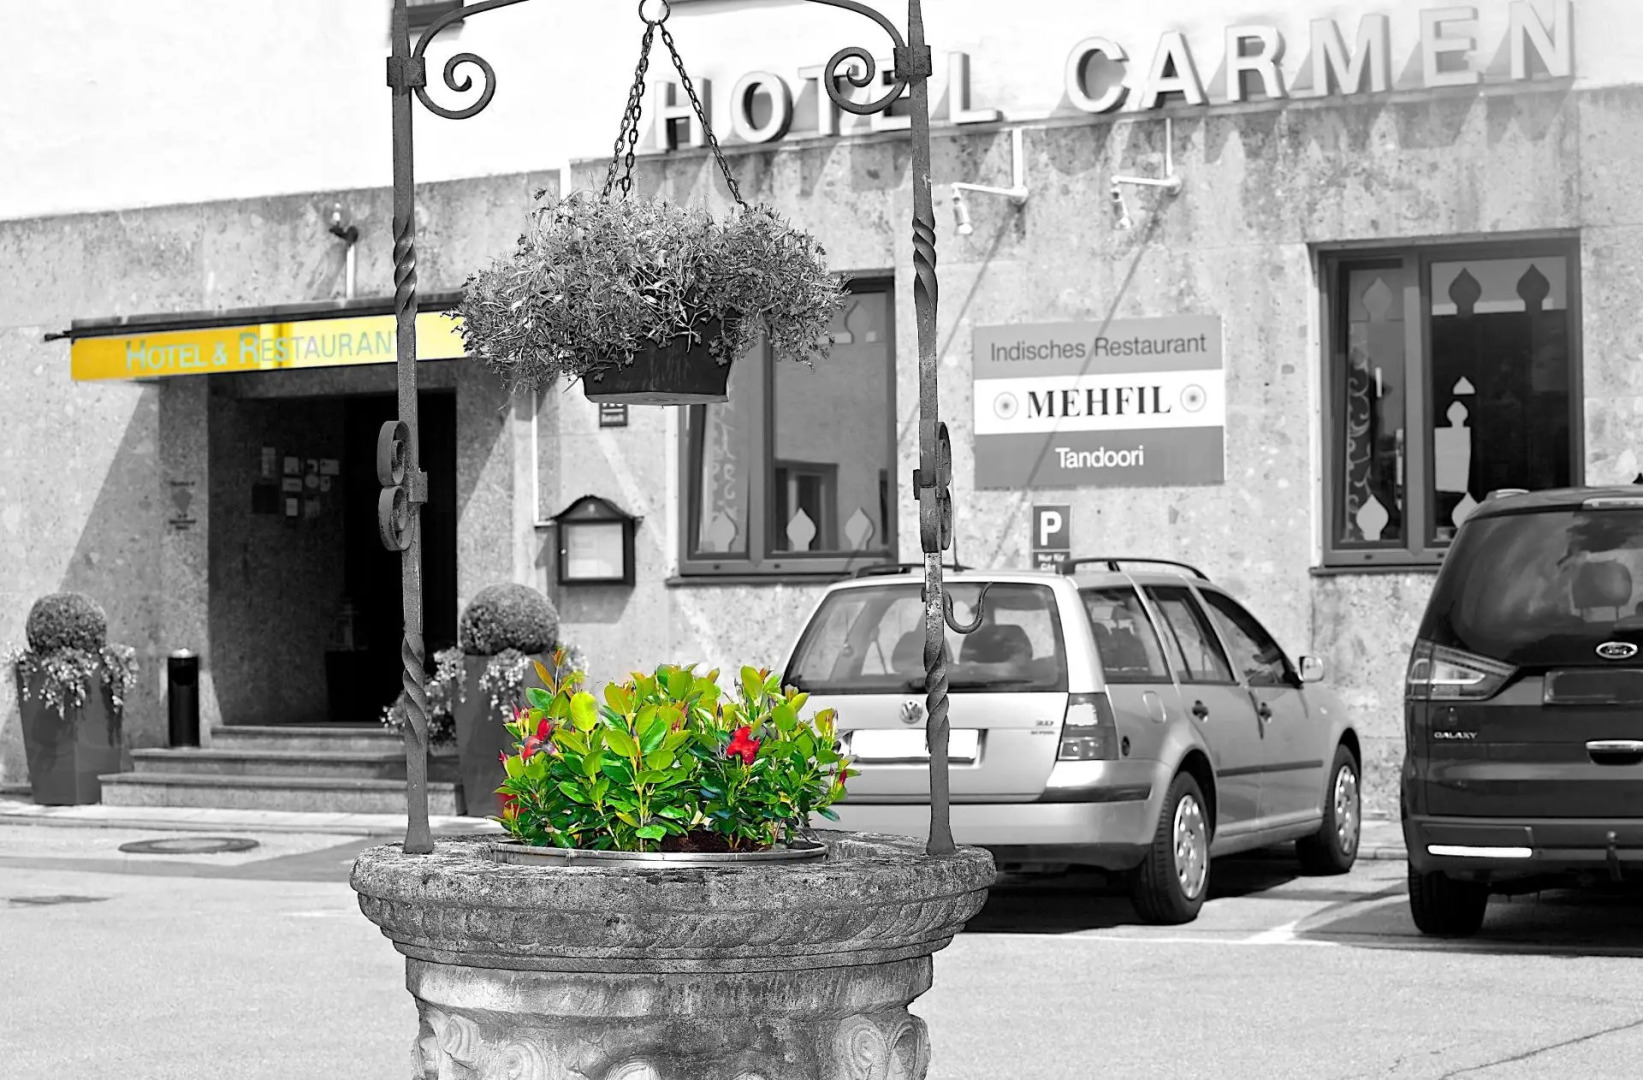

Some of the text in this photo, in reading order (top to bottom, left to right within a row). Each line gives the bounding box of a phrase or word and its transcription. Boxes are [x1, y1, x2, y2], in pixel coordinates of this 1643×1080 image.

[653, 0, 1577, 151] HOTEL CARMEN
[125, 330, 398, 370] HOTEL & RESTAURAN
[991, 334, 1207, 361] Indisches Restaurant
[1027, 385, 1172, 418] MEHFIL
[1055, 445, 1144, 468] Tandoori
[1040, 511, 1062, 546] P
[1434, 731, 1477, 739] GALAXY
